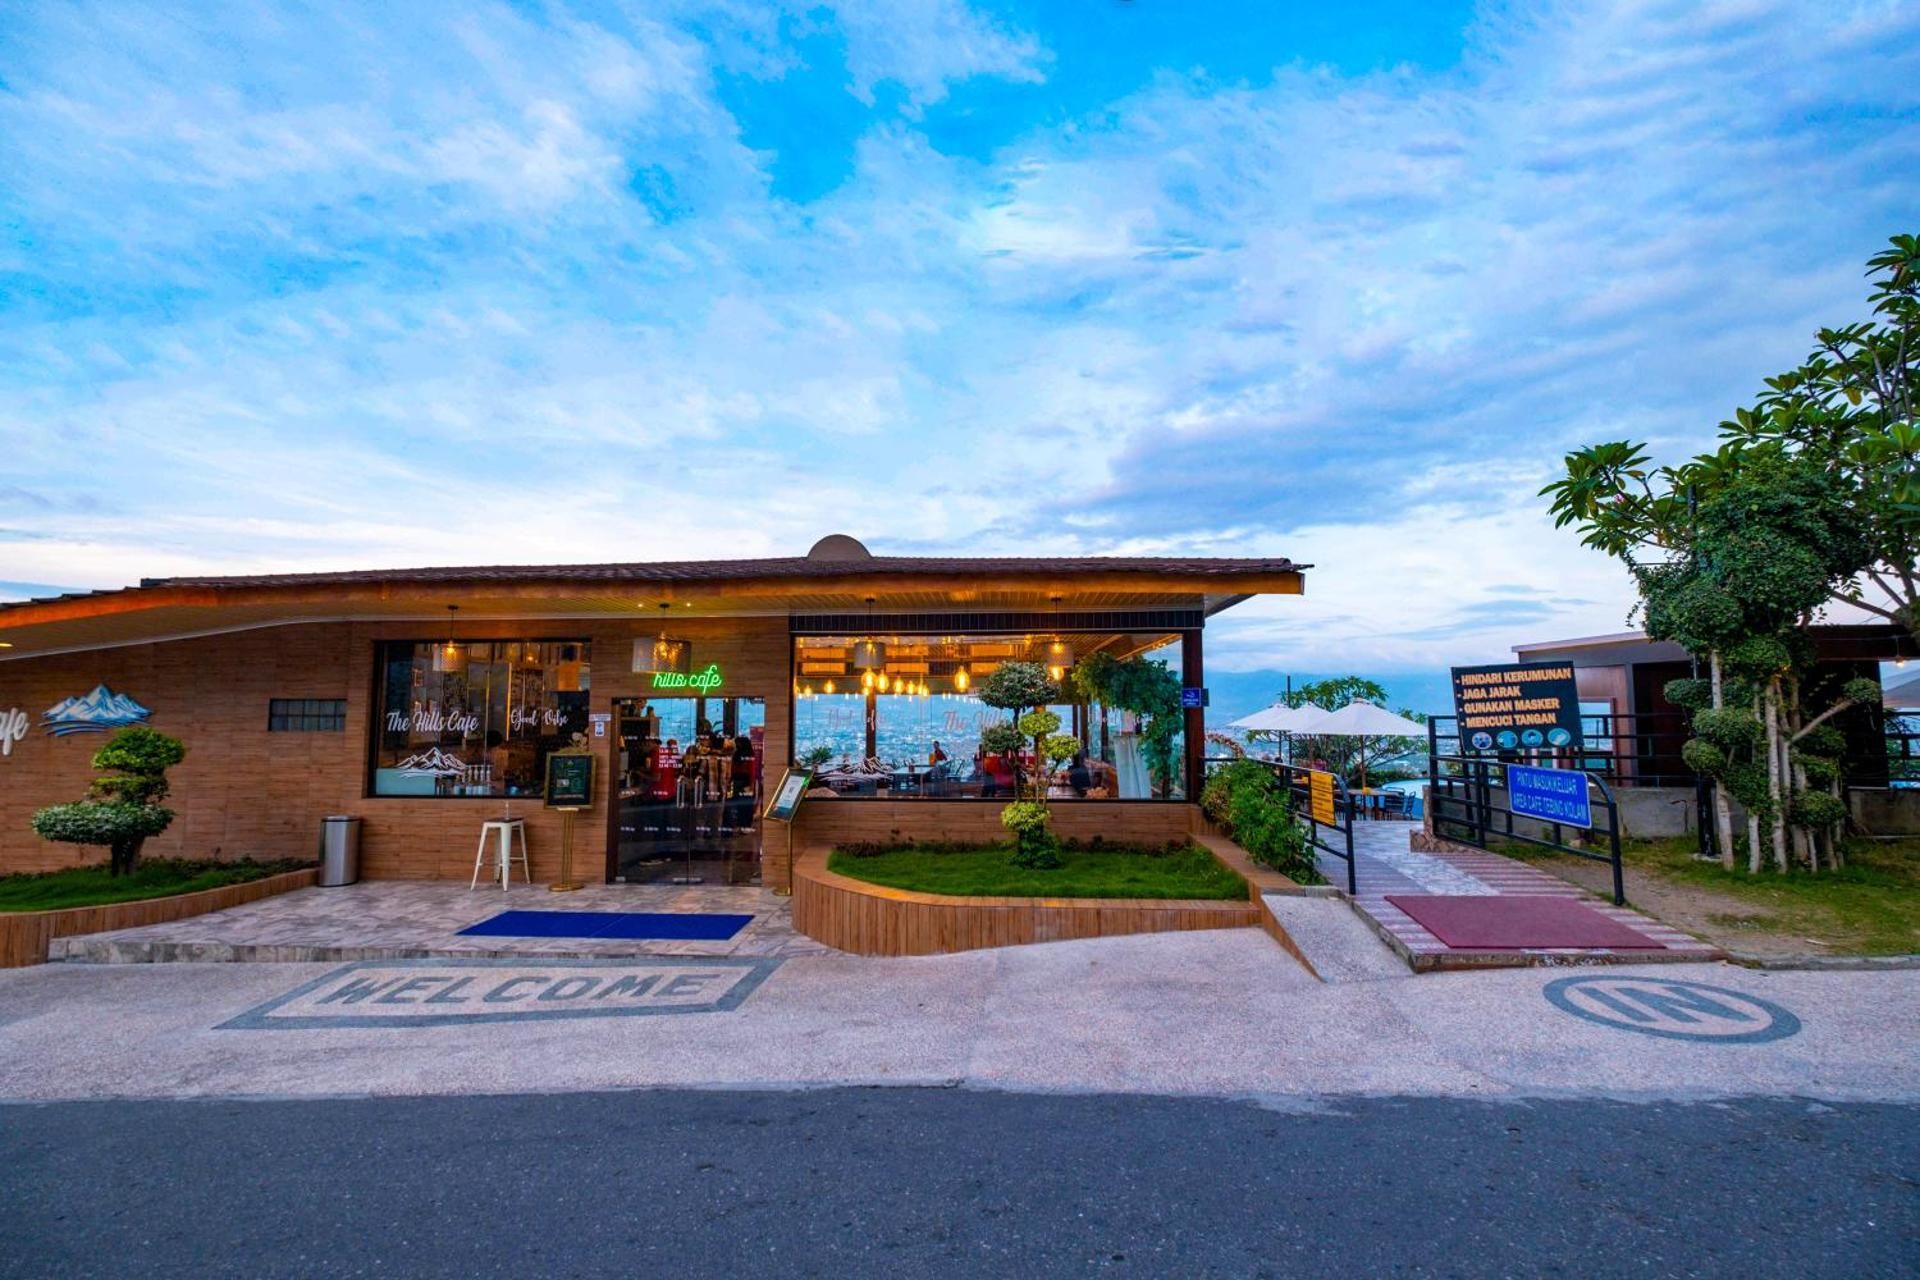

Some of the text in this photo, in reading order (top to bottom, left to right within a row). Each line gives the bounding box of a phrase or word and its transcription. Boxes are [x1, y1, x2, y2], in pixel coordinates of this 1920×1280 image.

[653, 664, 722, 695] hills cafe
[1461, 667, 1572, 685] HINDARI KERUMUNAN
[1462, 685, 1522, 699] JAGA JARAK
[1464, 697, 1561, 714] GUNAKAN MASKER
[386, 710, 481, 738] The Hills Cafe
[1466, 712, 1557, 729] MENCUCI TANGAN
[320, 973, 720, 1005] WELCOME
[1576, 985, 1758, 1023] IN
